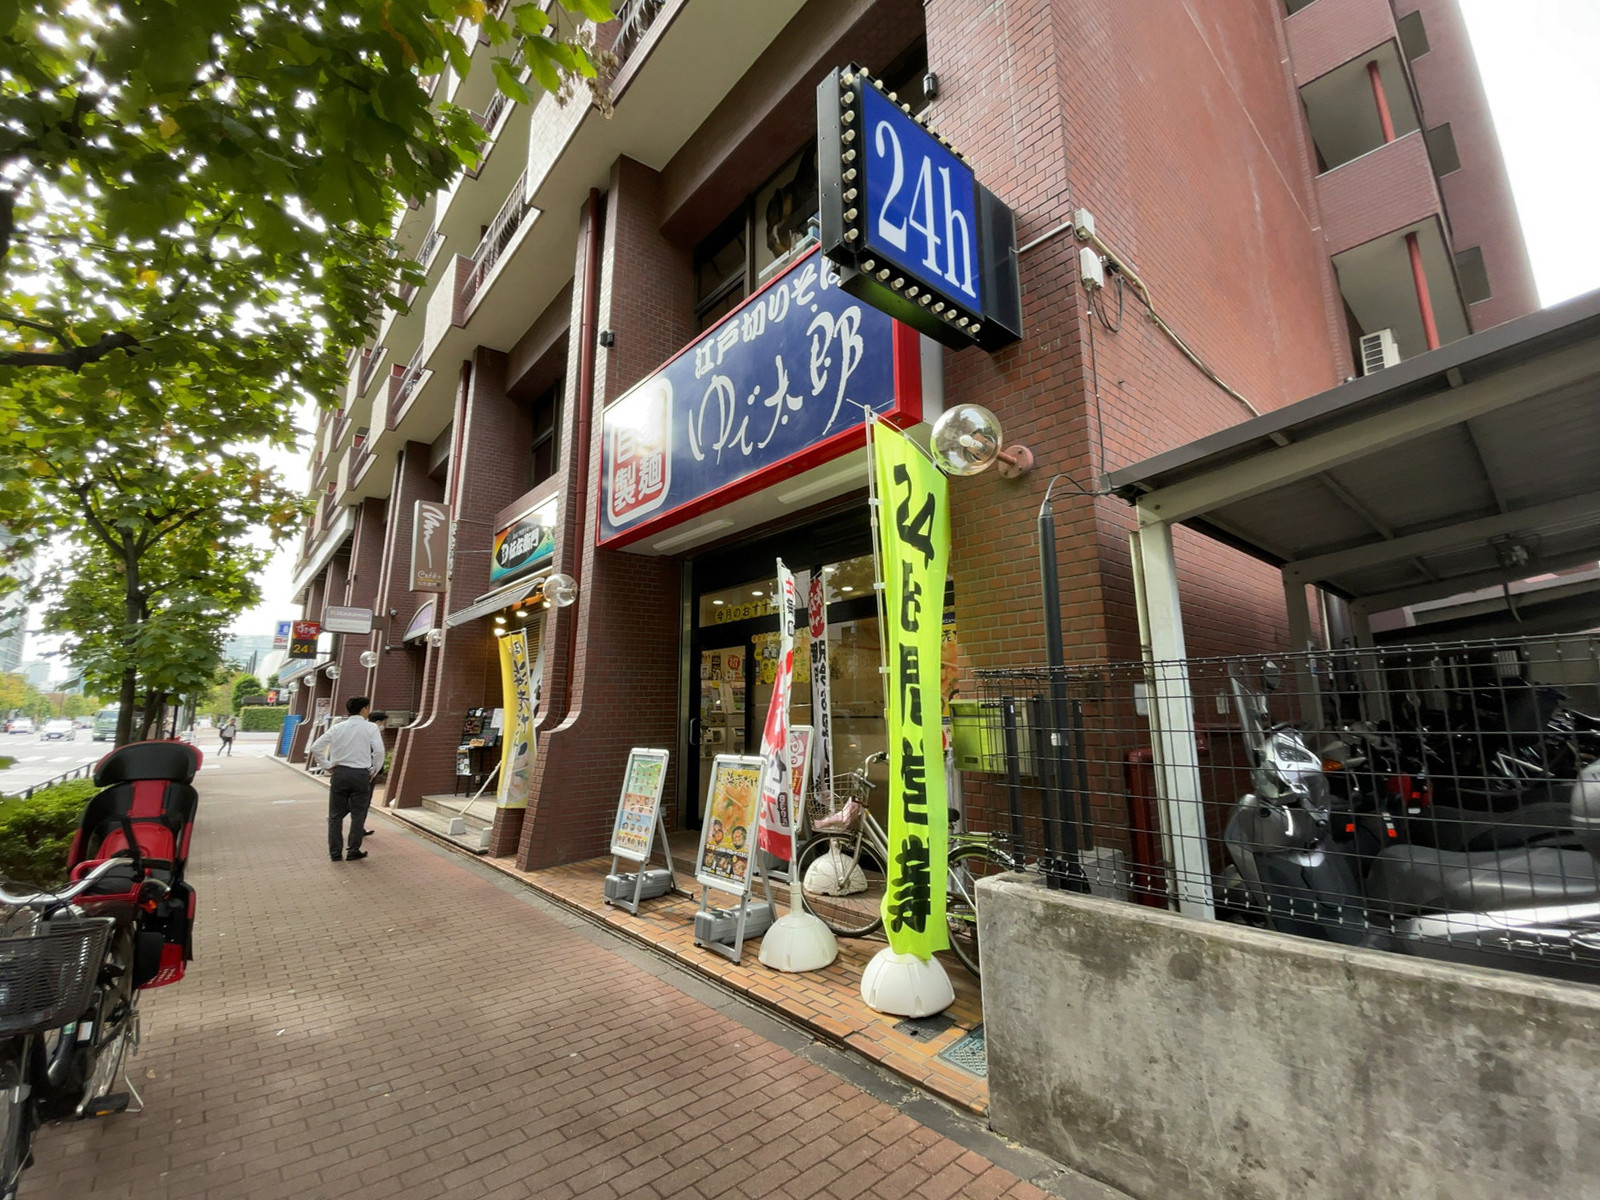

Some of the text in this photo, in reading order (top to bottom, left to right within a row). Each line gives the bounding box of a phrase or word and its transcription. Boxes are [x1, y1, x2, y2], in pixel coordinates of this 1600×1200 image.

[875, 120, 976, 299] 24h
[689, 305, 863, 465] ゆで太郎
